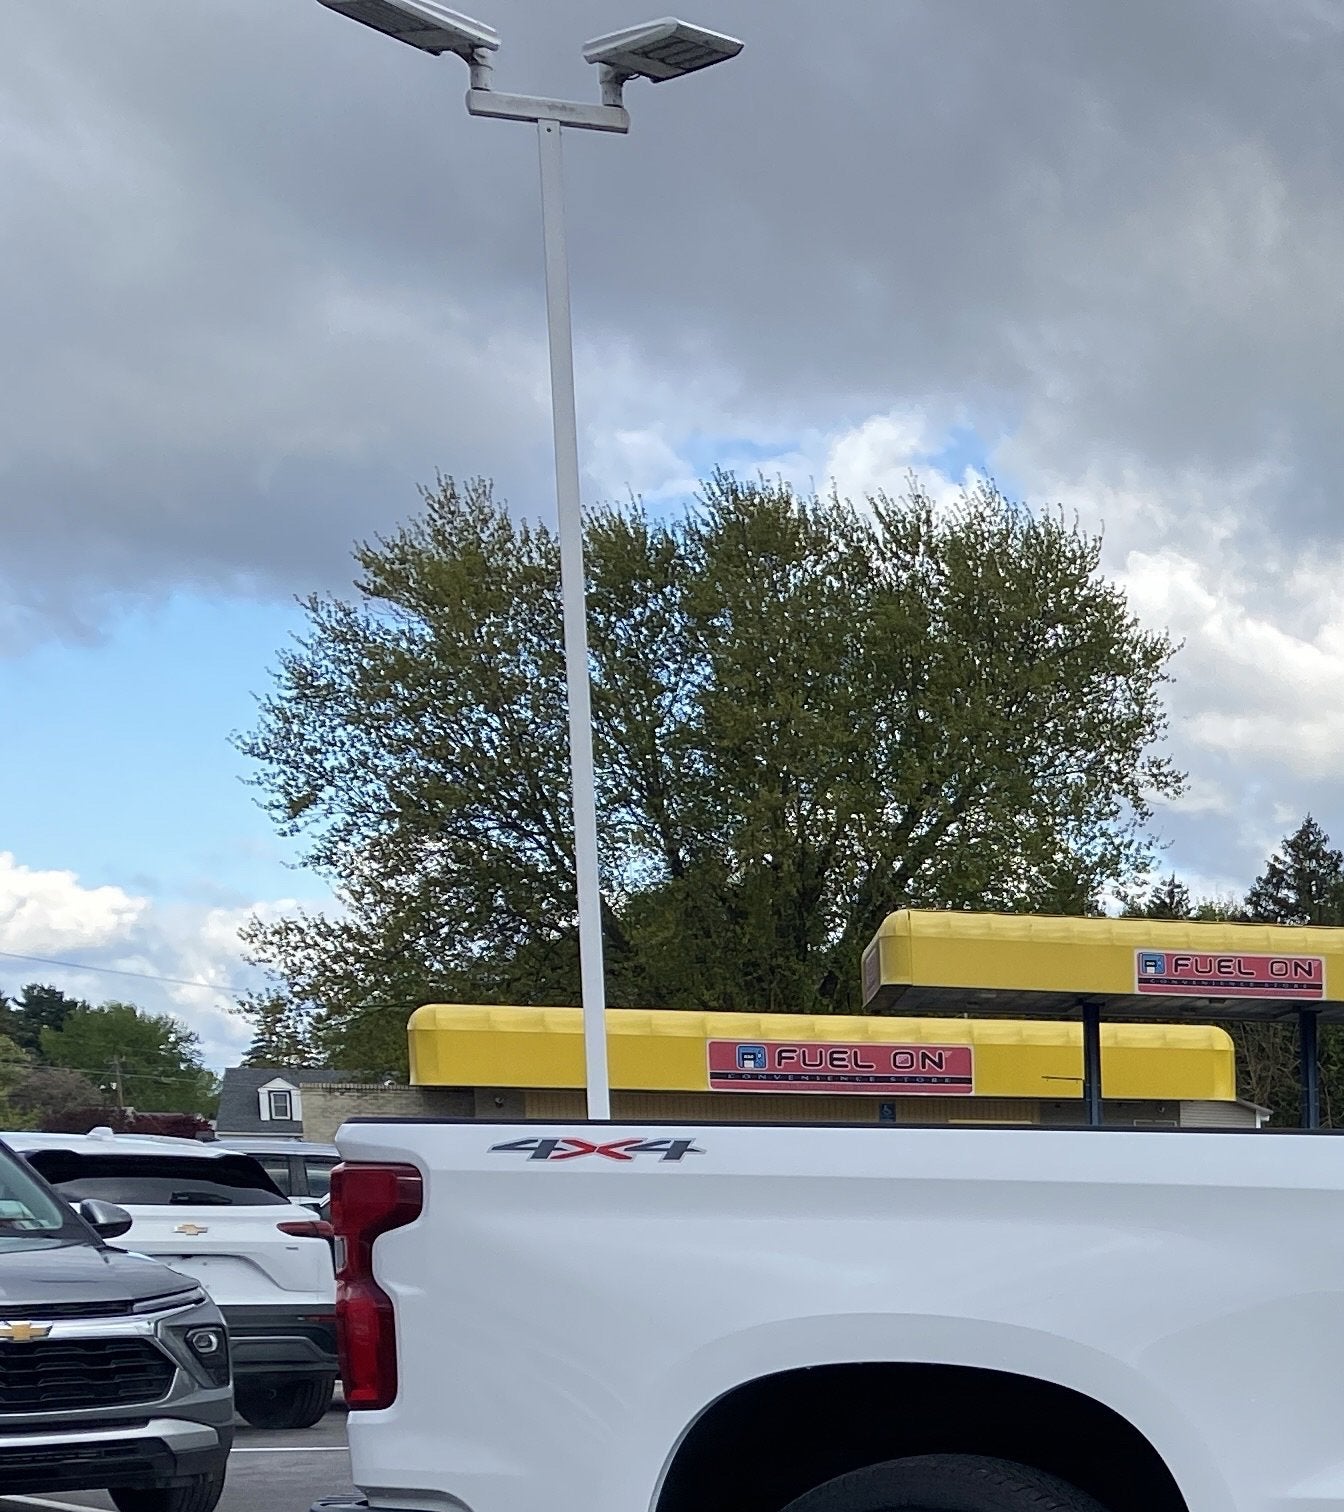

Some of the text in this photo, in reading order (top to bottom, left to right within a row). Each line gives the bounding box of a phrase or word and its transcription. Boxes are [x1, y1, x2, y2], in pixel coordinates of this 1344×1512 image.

[1172, 956, 1314, 979] FUEL ON
[775, 1047, 946, 1072] FUEL ON
[727, 1073, 952, 1084] CONVENIENCE STORE
[489, 1137, 707, 1161] 4X4
